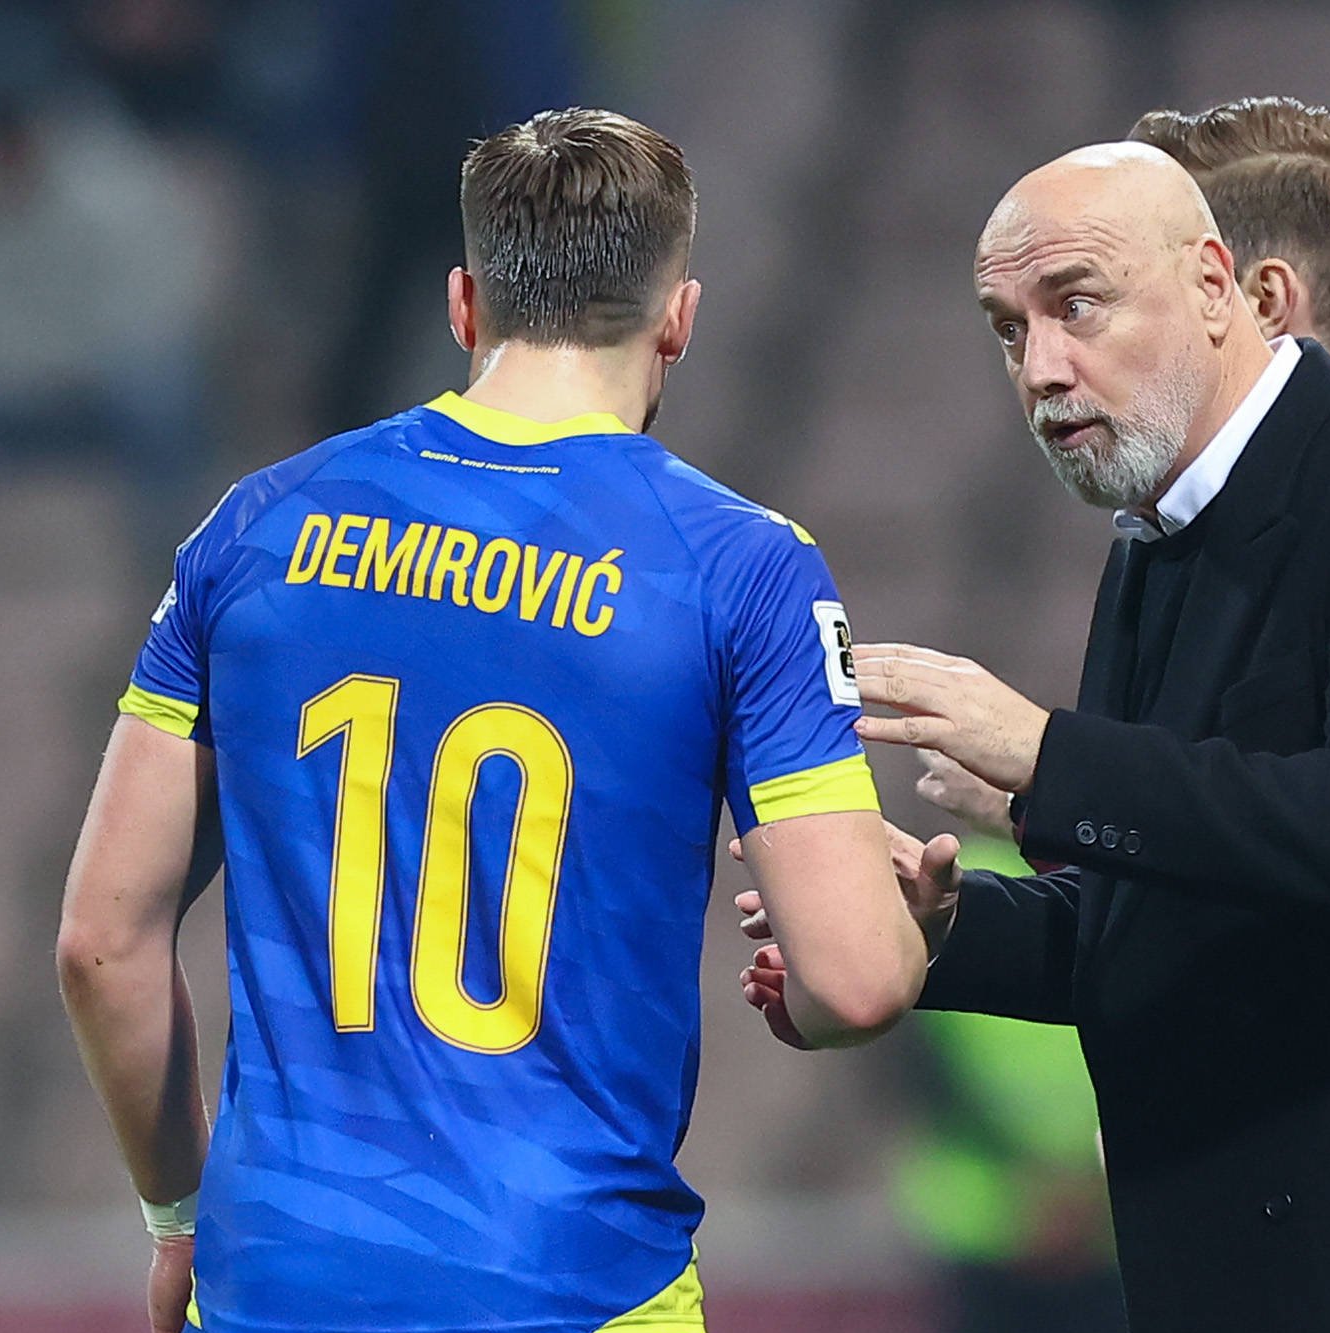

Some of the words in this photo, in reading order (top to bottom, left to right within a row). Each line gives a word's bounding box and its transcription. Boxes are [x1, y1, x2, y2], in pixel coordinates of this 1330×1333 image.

[420, 449, 459, 463] Bosnia
[461, 459, 486, 468] and
[285, 513, 625, 638] DEMIROVIĆ
[296, 673, 574, 1056] 10
